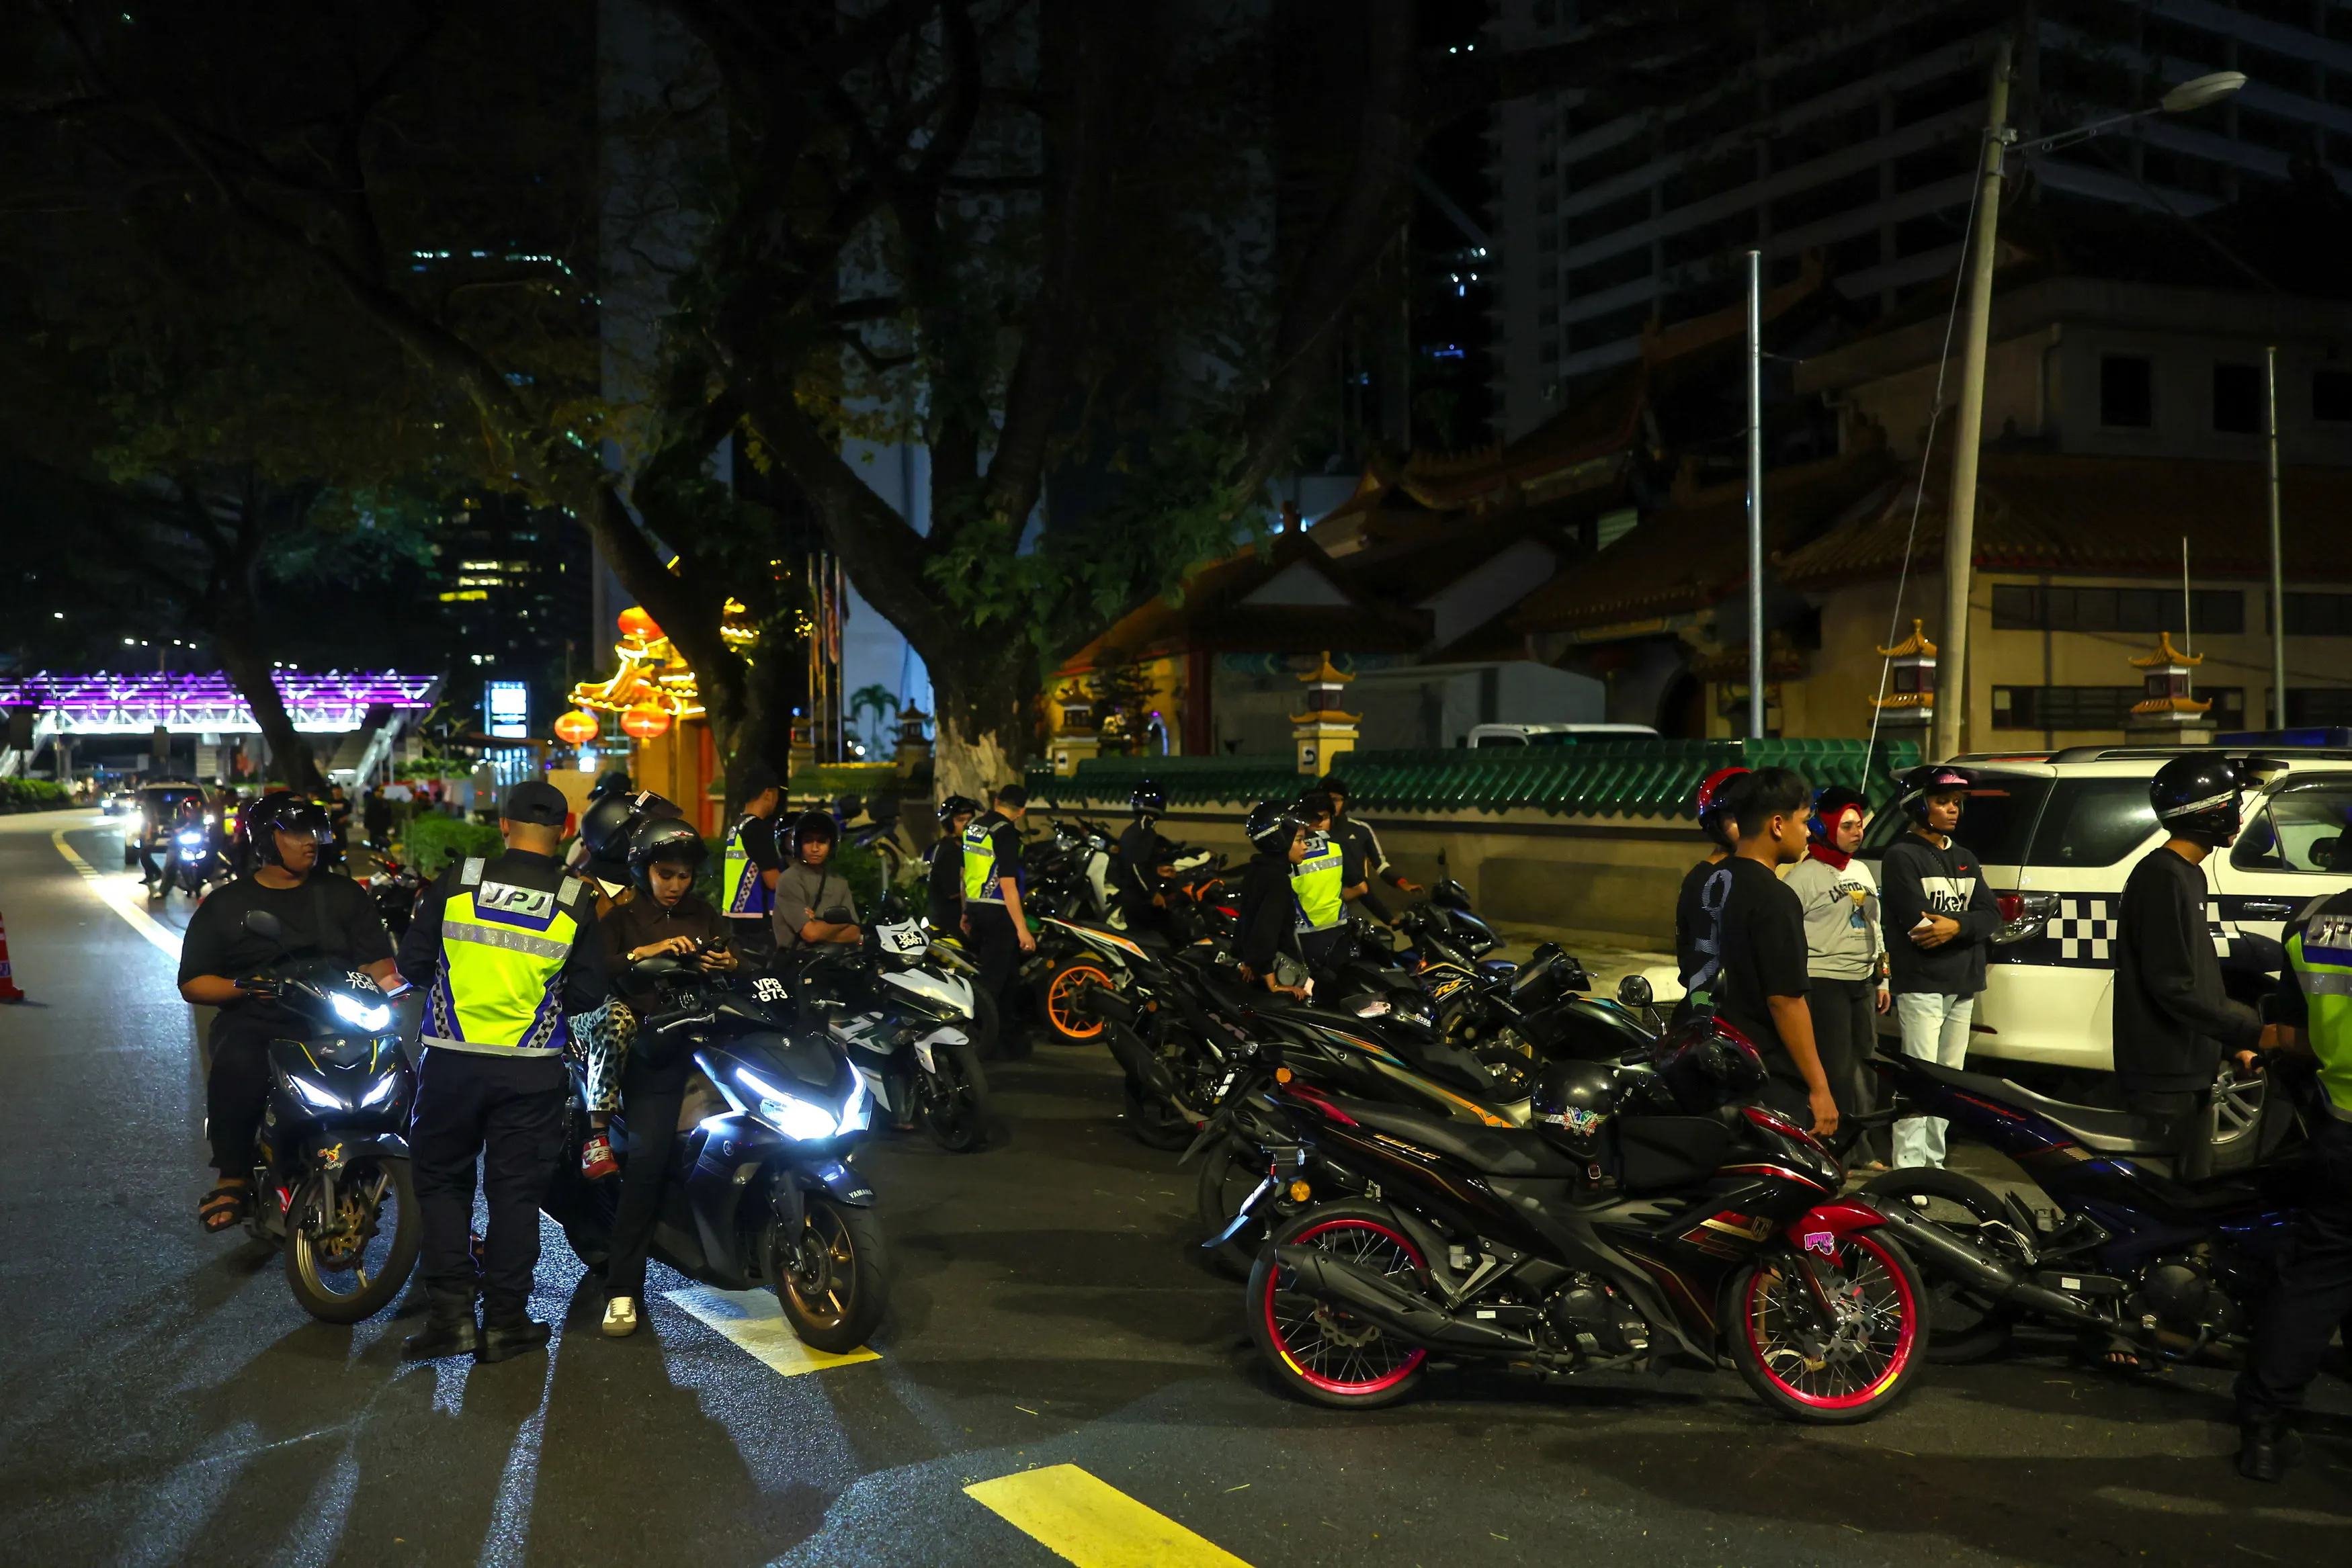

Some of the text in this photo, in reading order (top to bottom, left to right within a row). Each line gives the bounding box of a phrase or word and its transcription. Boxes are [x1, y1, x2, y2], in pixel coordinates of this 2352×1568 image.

[486, 888, 546, 911] JPJ
[753, 977, 782, 991] VPB
[758, 988, 788, 1002] 673
[848, 1188, 874, 1199] YAMAHA
